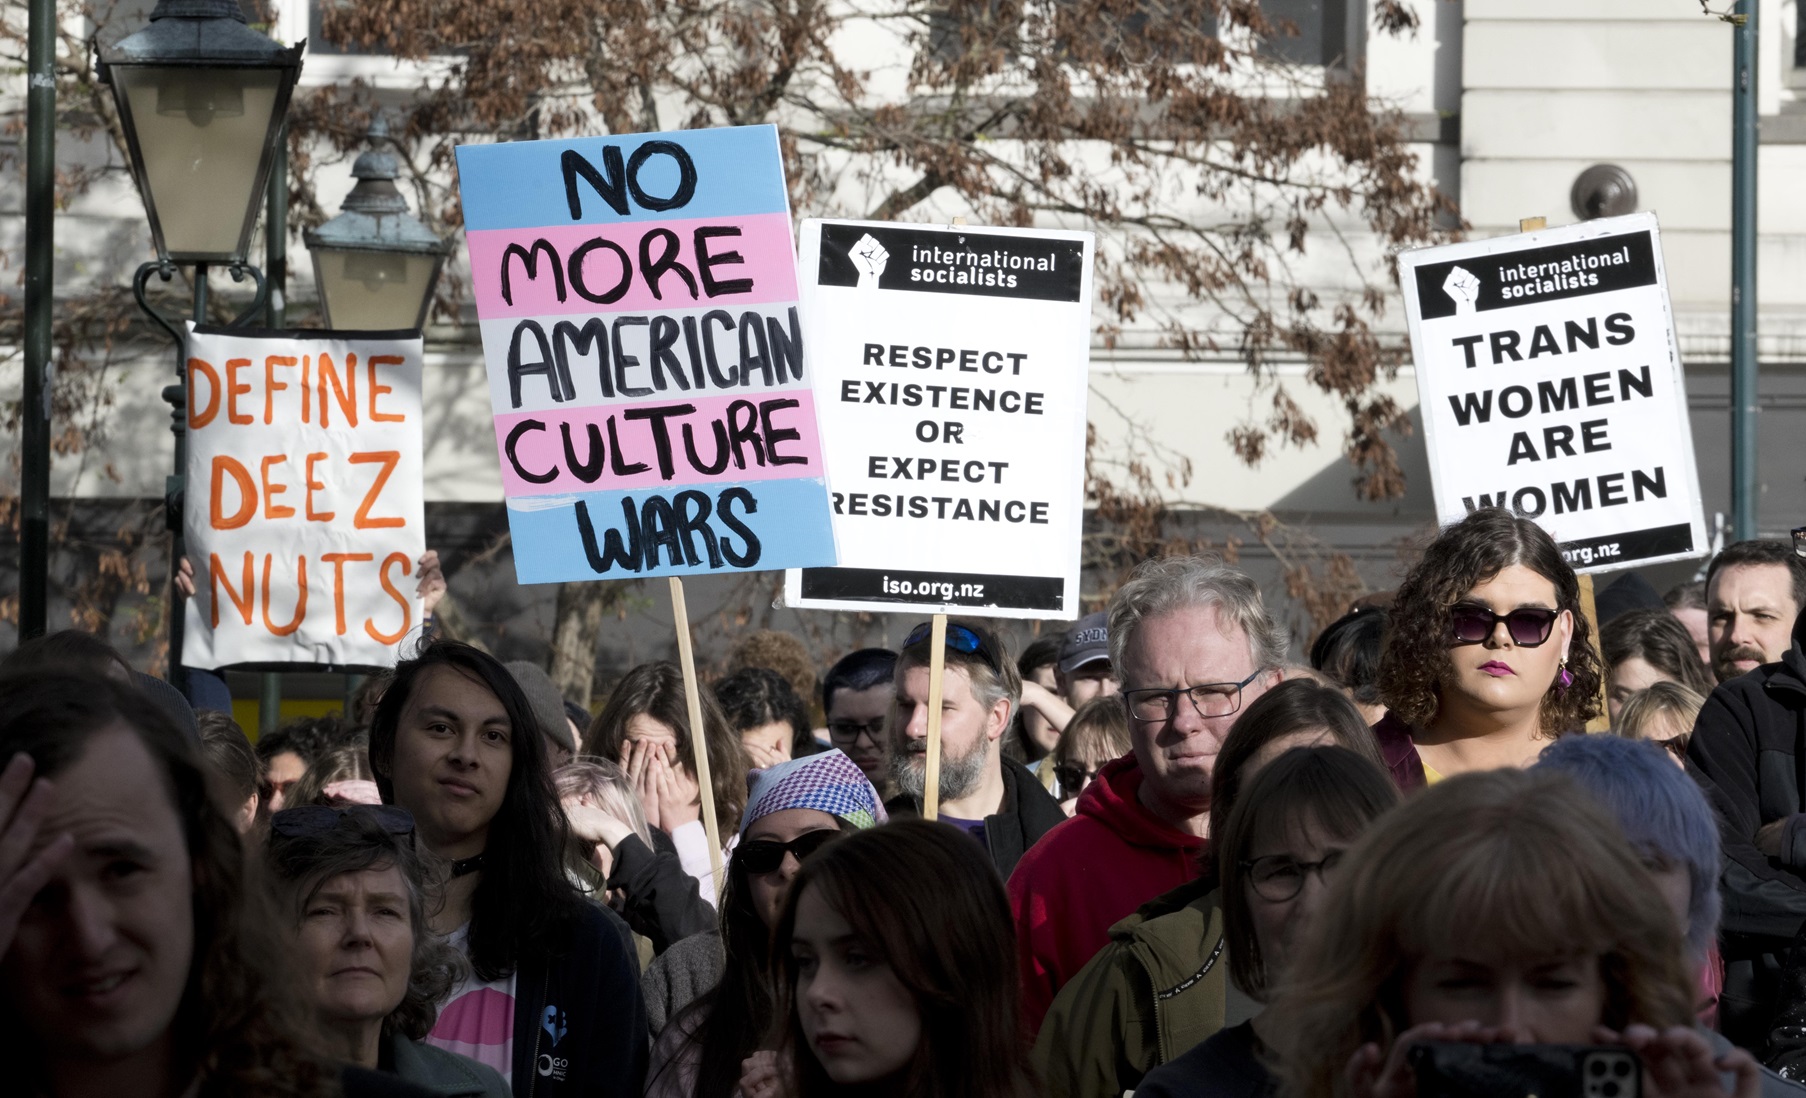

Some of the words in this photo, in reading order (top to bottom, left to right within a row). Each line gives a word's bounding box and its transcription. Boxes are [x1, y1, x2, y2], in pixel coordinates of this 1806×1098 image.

[561, 140, 698, 220] NO
[500, 226, 754, 306] MORE
[910, 266, 1018, 288] socialists
[912, 244, 1056, 272] international
[1499, 246, 1630, 282] international
[1501, 271, 1599, 299] socialists
[507, 306, 804, 409] AMERICAN
[863, 343, 1028, 376] RESPECT
[1452, 312, 1636, 369] TRANS
[187, 352, 405, 430] DEFINE
[840, 380, 1045, 415] EXISTENCE
[1447, 365, 1654, 426] WOMEN
[504, 398, 808, 484] CULTURE
[915, 420, 964, 444] OR
[1506, 418, 1612, 466] ARE
[209, 450, 406, 530] DEEZ
[868, 456, 1009, 484] EXPECT
[574, 487, 761, 574] WARS
[832, 492, 1049, 524] RESISTANCE
[209, 550, 412, 646] NUTS
[883, 576, 984, 600] iso.org.nz
